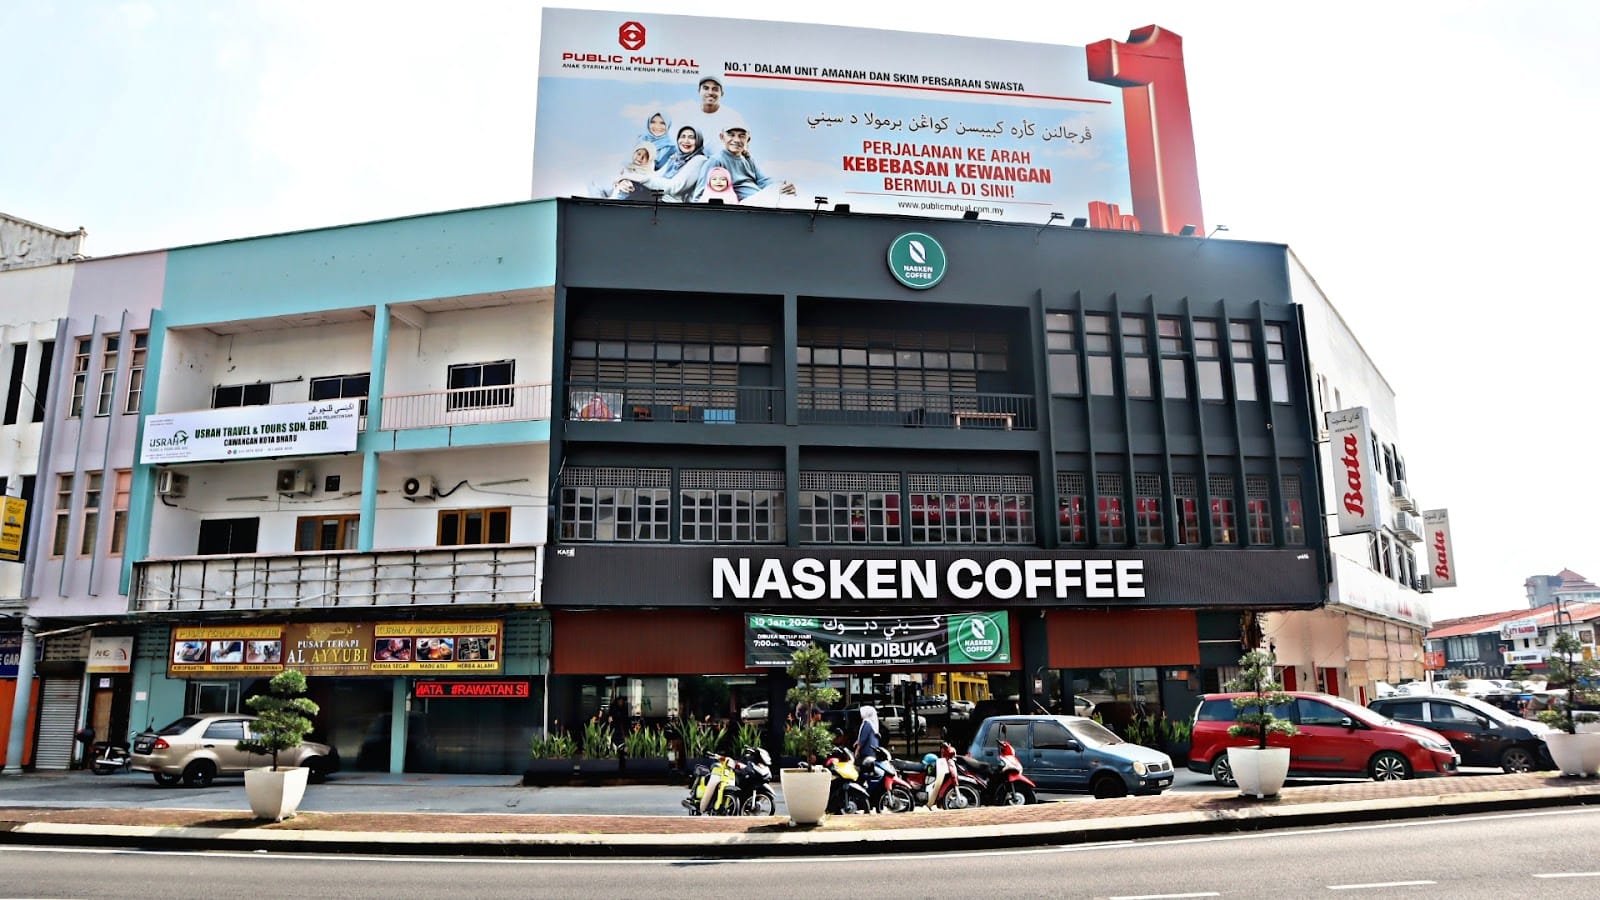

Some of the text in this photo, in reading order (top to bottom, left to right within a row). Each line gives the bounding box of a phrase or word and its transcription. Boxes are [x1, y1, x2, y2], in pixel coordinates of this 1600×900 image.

[562, 53, 699, 68] PUBLIC MUTUAL
[754, 63, 791, 75] DALAM
[794, 66, 819, 76] UNIT
[821, 68, 866, 80] AMANAH
[870, 71, 890, 81] DAN
[893, 73, 919, 84] SKIM
[922, 75, 982, 89] PERSARAAN
[984, 80, 1025, 92] SWASTA
[807, 112, 844, 129] سيني
[849, 114, 858, 124] د
[863, 140, 1031, 165] PERJALANAN KE ARAH
[843, 155, 1051, 184] KEBEBASAN KEWANGAN
[884, 177, 1015, 198] BERMULA DI SINI!
[898, 201, 1005, 216] www.publicmutualcom.my
[904, 265, 933, 273] NASKEN
[195, 420, 329, 440] USRAH TRAVEL & TOURS SDN. BHD.
[149, 436, 180, 448] USRAH
[224, 434, 298, 447] CAWANGAN KOTA BHARU
[1341, 433, 1365, 518] Bata
[1433, 530, 1449, 581] Bata
[712, 557, 1146, 600] NASKEN COFFEE
[768, 618, 786, 626] Jan
[823, 617, 878, 635] دبوك
[297, 639, 359, 649] PUSAT TERAPI
[830, 642, 937, 658] KINI DIBUKA
[4, 653, 21, 665] GAR
[287, 648, 368, 664] AL AYYUBI
